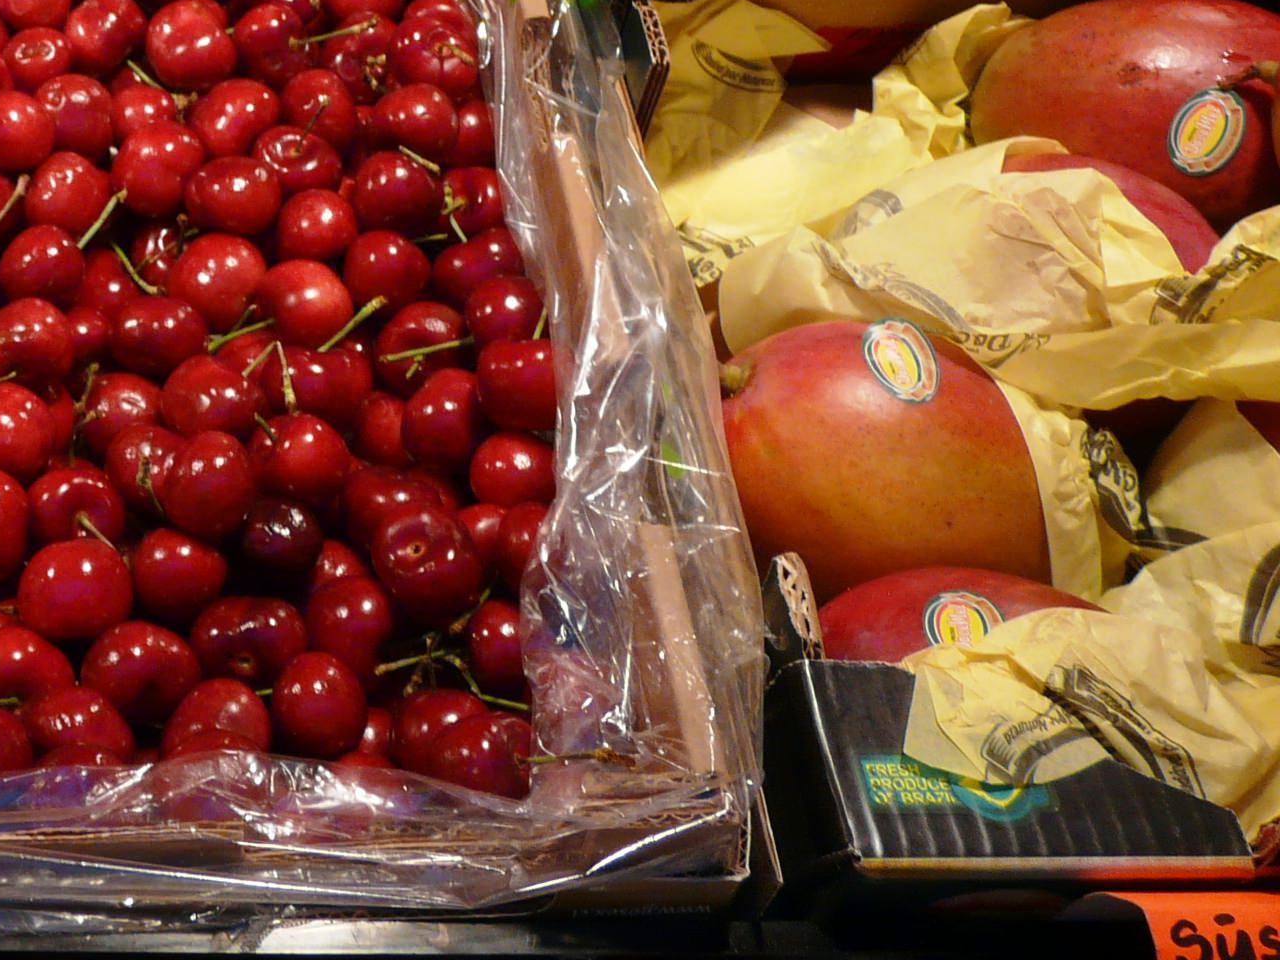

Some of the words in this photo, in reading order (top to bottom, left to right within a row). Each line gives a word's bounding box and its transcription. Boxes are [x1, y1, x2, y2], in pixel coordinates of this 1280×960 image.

[866, 763, 921, 778] FRESH
[869, 777, 951, 791] PRODUCE
[873, 792, 898, 805] OF
